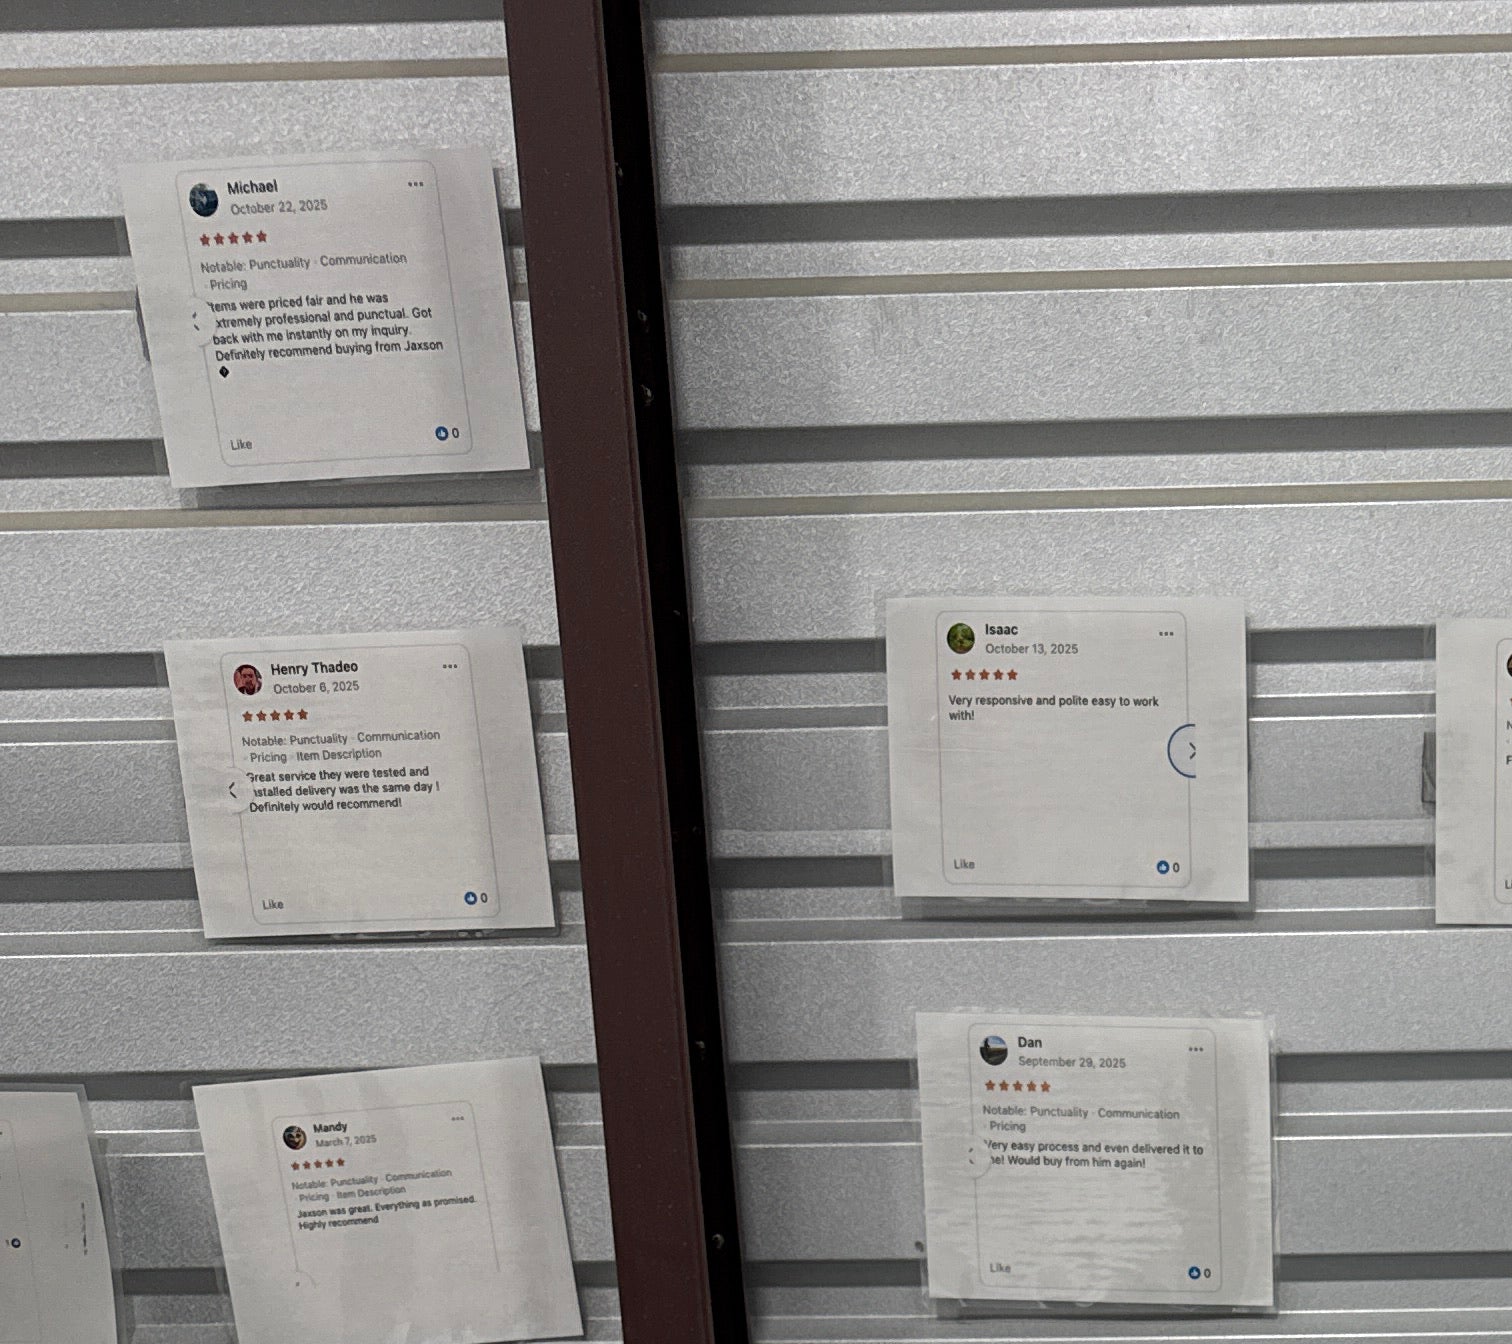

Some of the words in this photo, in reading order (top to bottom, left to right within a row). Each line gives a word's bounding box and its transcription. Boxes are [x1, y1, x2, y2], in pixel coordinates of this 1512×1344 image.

[227, 179, 278, 194] Michael
[231, 202, 275, 215] October
[278, 200, 296, 214] 22,
[299, 199, 328, 212] 2025
[200, 262, 246, 273] Notable:
[249, 256, 310, 270] Punctuality
[320, 252, 407, 266] Communication
[210, 279, 248, 291] Pricing
[207, 301, 237, 312] tems
[240, 300, 266, 310] were
[268, 297, 303, 310] priced
[306, 294, 323, 306] fair
[327, 294, 346, 305] and
[349, 293, 363, 304] he
[366, 294, 388, 303] was
[216, 314, 262, 328] xtremely
[265, 311, 330, 327] professional
[334, 310, 354, 321] and
[358, 308, 409, 322] punctual.
[412, 307, 432, 318] Got
[213, 334, 239, 345] back
[241, 331, 264, 343] with
[267, 332, 283, 341] me
[286, 327, 332, 340] instantly
[335, 328, 348, 338] on
[352, 327, 368, 339] my
[216, 348, 265, 361] Definitely
[268, 344, 332, 358] recommend
[335, 342, 372, 355] buying
[375, 341, 401, 352] from
[404, 340, 443, 351] Jaxson
[230, 439, 253, 451] Like
[985, 624, 1018, 636] Isaac
[985, 643, 1029, 655] October
[1030, 644, 1047, 656] 13,
[1051, 644, 1078, 654] 2025
[270, 663, 308, 676] Henry
[311, 660, 358, 674] Thadeo
[273, 683, 316, 694] October
[333, 681, 360, 692] 2025
[948, 695, 972, 708] Very
[975, 695, 1033, 708] responsive
[1036, 695, 1056, 706] and
[1058, 695, 1089, 708] polite
[1091, 698, 1116, 709] easy
[1119, 697, 1130, 707] to
[1133, 695, 1159, 707] work
[948, 710, 975, 721] with!
[278, 771, 316, 781] service
[319, 770, 341, 781] they
[345, 769, 369, 779] were
[372, 767, 406, 778] tested
[410, 766, 429, 777] and
[254, 786, 292, 797] stalled
[295, 786, 336, 797] delivery
[339, 785, 359, 794] was
[362, 783, 379, 793] the
[382, 783, 410, 792] same
[414, 782, 433, 793] day
[249, 801, 300, 813] Definitely
[303, 800, 334, 810] would
[337, 798, 402, 810] recommend!
[953, 859, 975, 870] Like
[1018, 1037, 1042, 1048] Dan
[1018, 1056, 1076, 1069] September
[1079, 1057, 1096, 1069] 29,
[1099, 1057, 1126, 1068] 2025
[313, 1122, 348, 1133] Mandy
[315, 1138, 342, 1147] March
[354, 1135, 377, 1144] 2025
[984, 1139, 1008, 1151] Very
[1011, 1142, 1035, 1152] easy
[1038, 1142, 1079, 1152] process
[1082, 1142, 1101, 1153] and
[1104, 1144, 1129, 1153] even
[1132, 1143, 1180, 1154] delivered
[1183, 1144, 1190, 1154] it
[1192, 1145, 1203, 1155] to
[991, 1156, 1004, 1165] e!
[1008, 1155, 1040, 1165] Would
[1043, 1156, 1062, 1168] buy
[1065, 1156, 1089, 1166] from
[1092, 1157, 1111, 1167] him
[1114, 1158, 1146, 1170] again!
[298, 1209, 328, 1218] Jaxson
[329, 1207, 346, 1216] was
[375, 1200, 420, 1212] Everything
[299, 1220, 327, 1231] Highly
[328, 1216, 379, 1227] recommend
